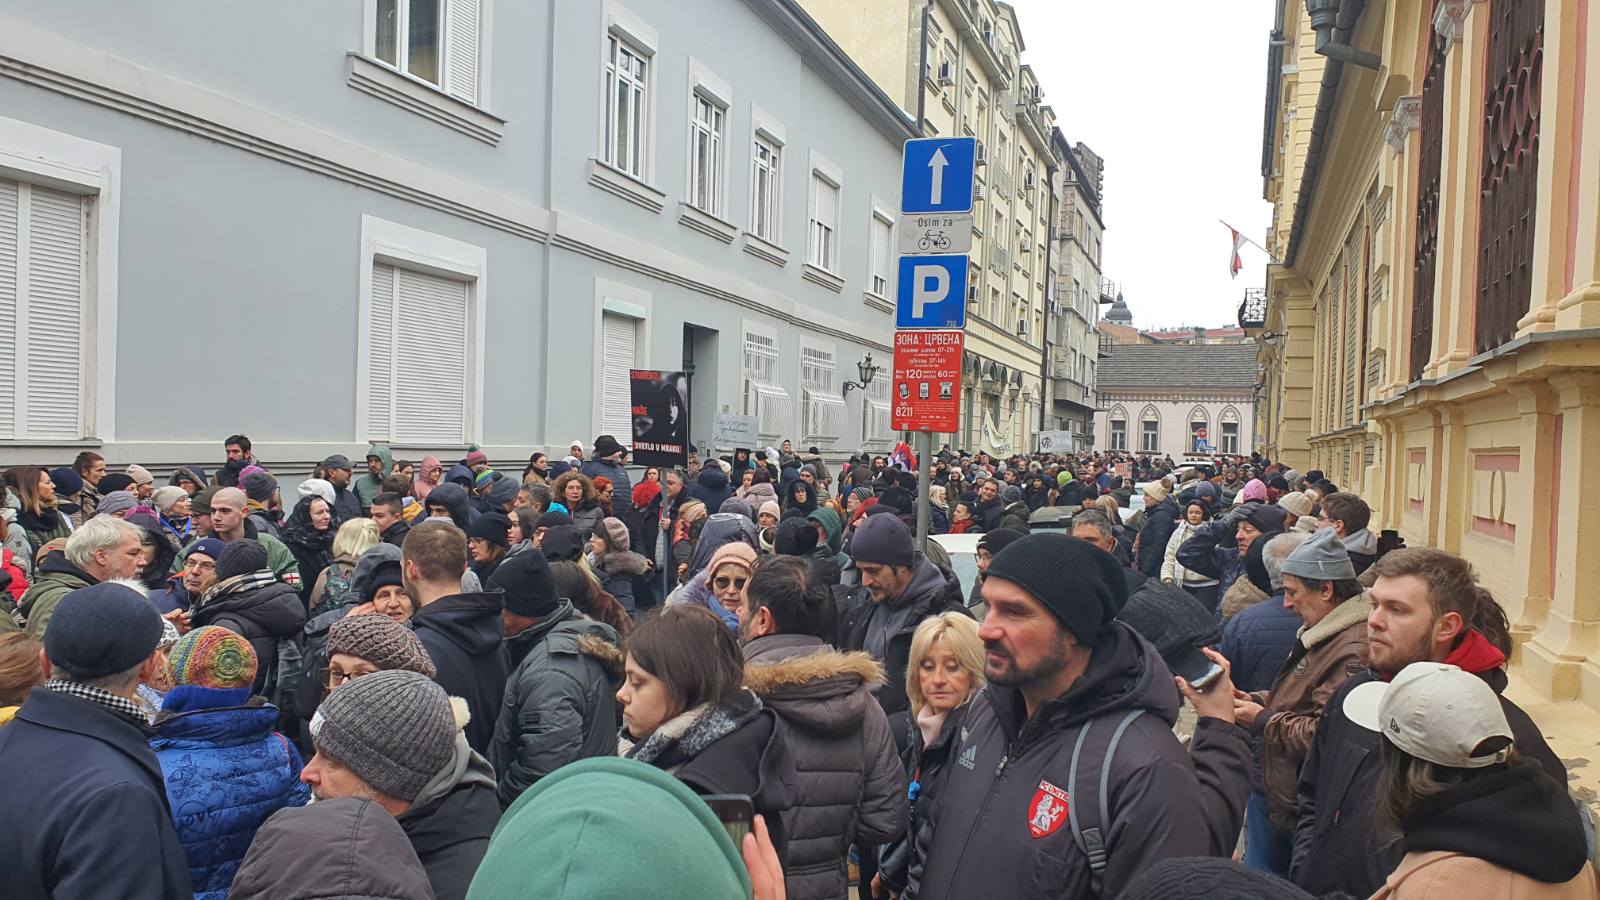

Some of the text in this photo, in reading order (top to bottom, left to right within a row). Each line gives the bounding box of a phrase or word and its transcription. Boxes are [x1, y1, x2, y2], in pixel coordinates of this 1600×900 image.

[918, 218, 953, 227] Osim za
[911, 264, 950, 319] P
[896, 333, 960, 346] ЗОНА: ЦРВЕНА
[906, 369, 923, 379] 120
[895, 406, 913, 417] 8211
[634, 441, 655, 451] SVETLO
[655, 443, 660, 452] U
[959, 757, 975, 770] didas
